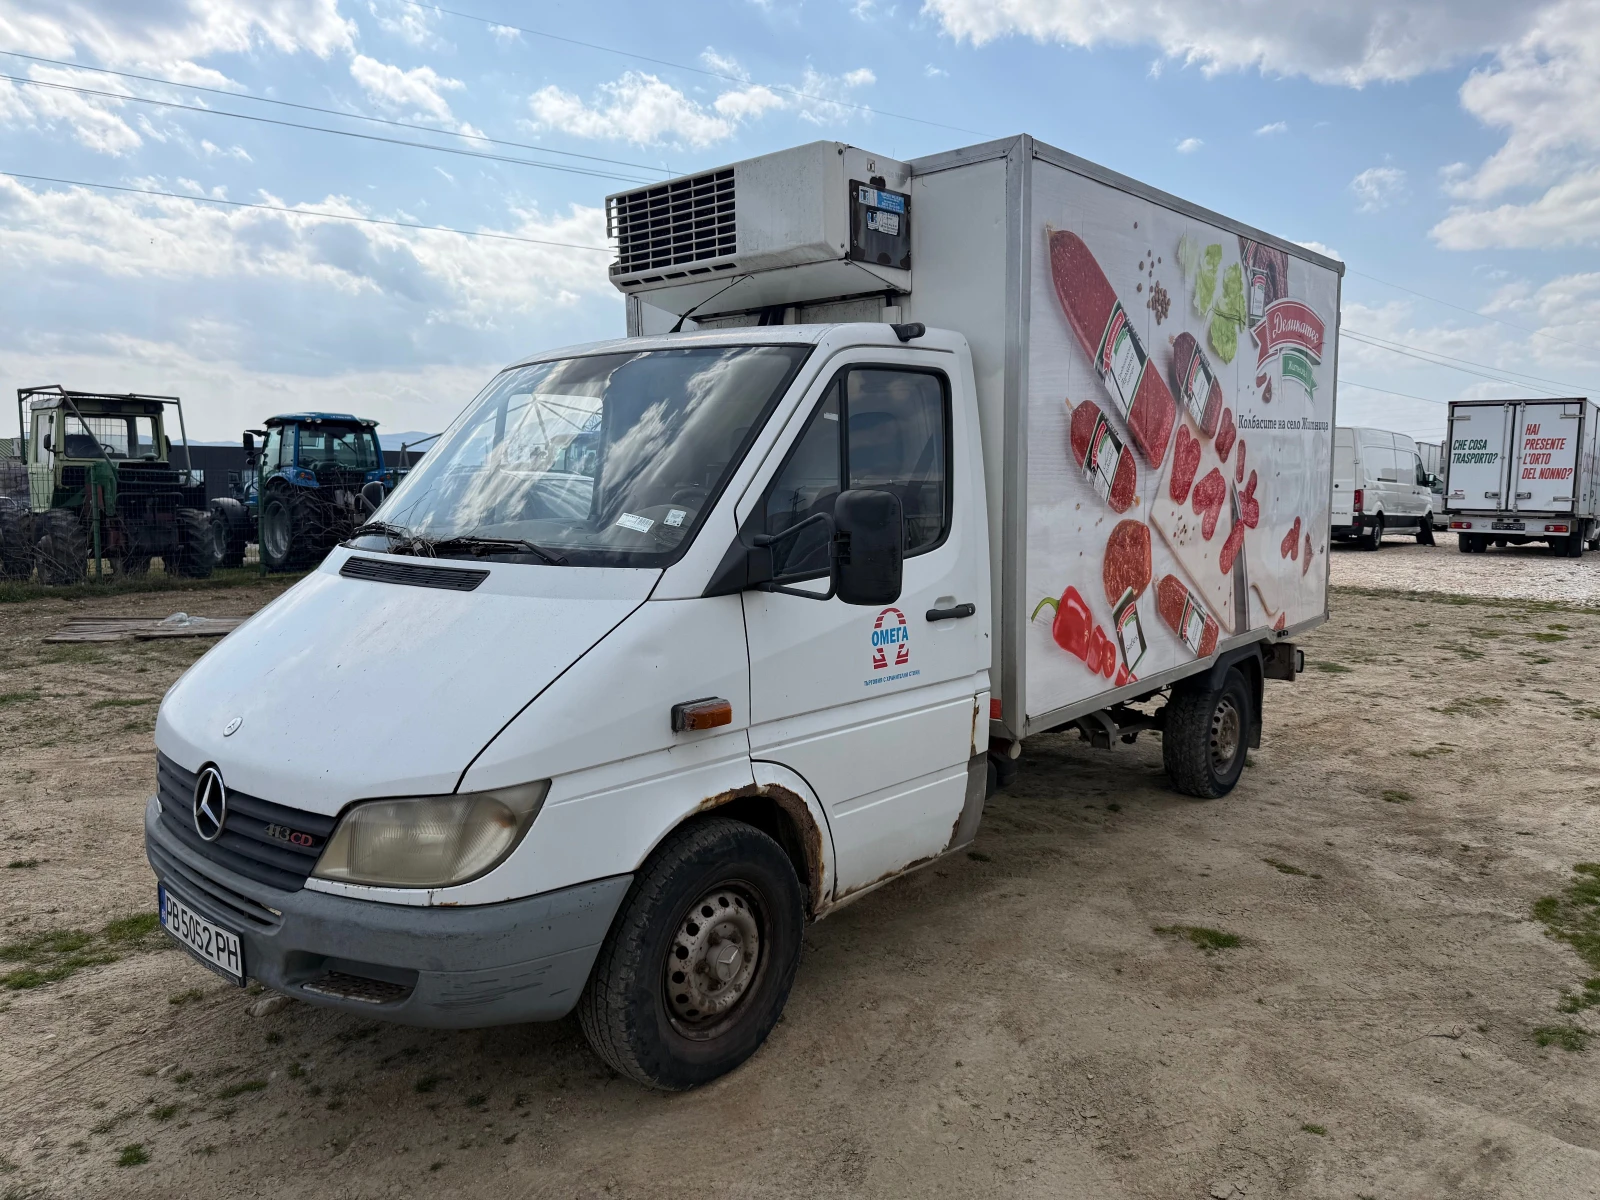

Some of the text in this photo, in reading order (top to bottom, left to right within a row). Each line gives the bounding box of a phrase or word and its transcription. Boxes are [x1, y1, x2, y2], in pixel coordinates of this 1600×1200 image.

[1272, 311, 1318, 343] Деликатес
[1238, 415, 1329, 432] Колбасите на село Житница
[1525, 424, 1541, 435] HAI
[1453, 439, 1487, 450] CHE COSA
[1524, 438, 1567, 450] PRESENTE
[1452, 453, 1498, 464] TRASPORTO?
[1523, 453, 1551, 465] L'ORTO
[1522, 468, 1573, 480] DEL NONNO?
[871, 626, 909, 646] ОМЕГА
